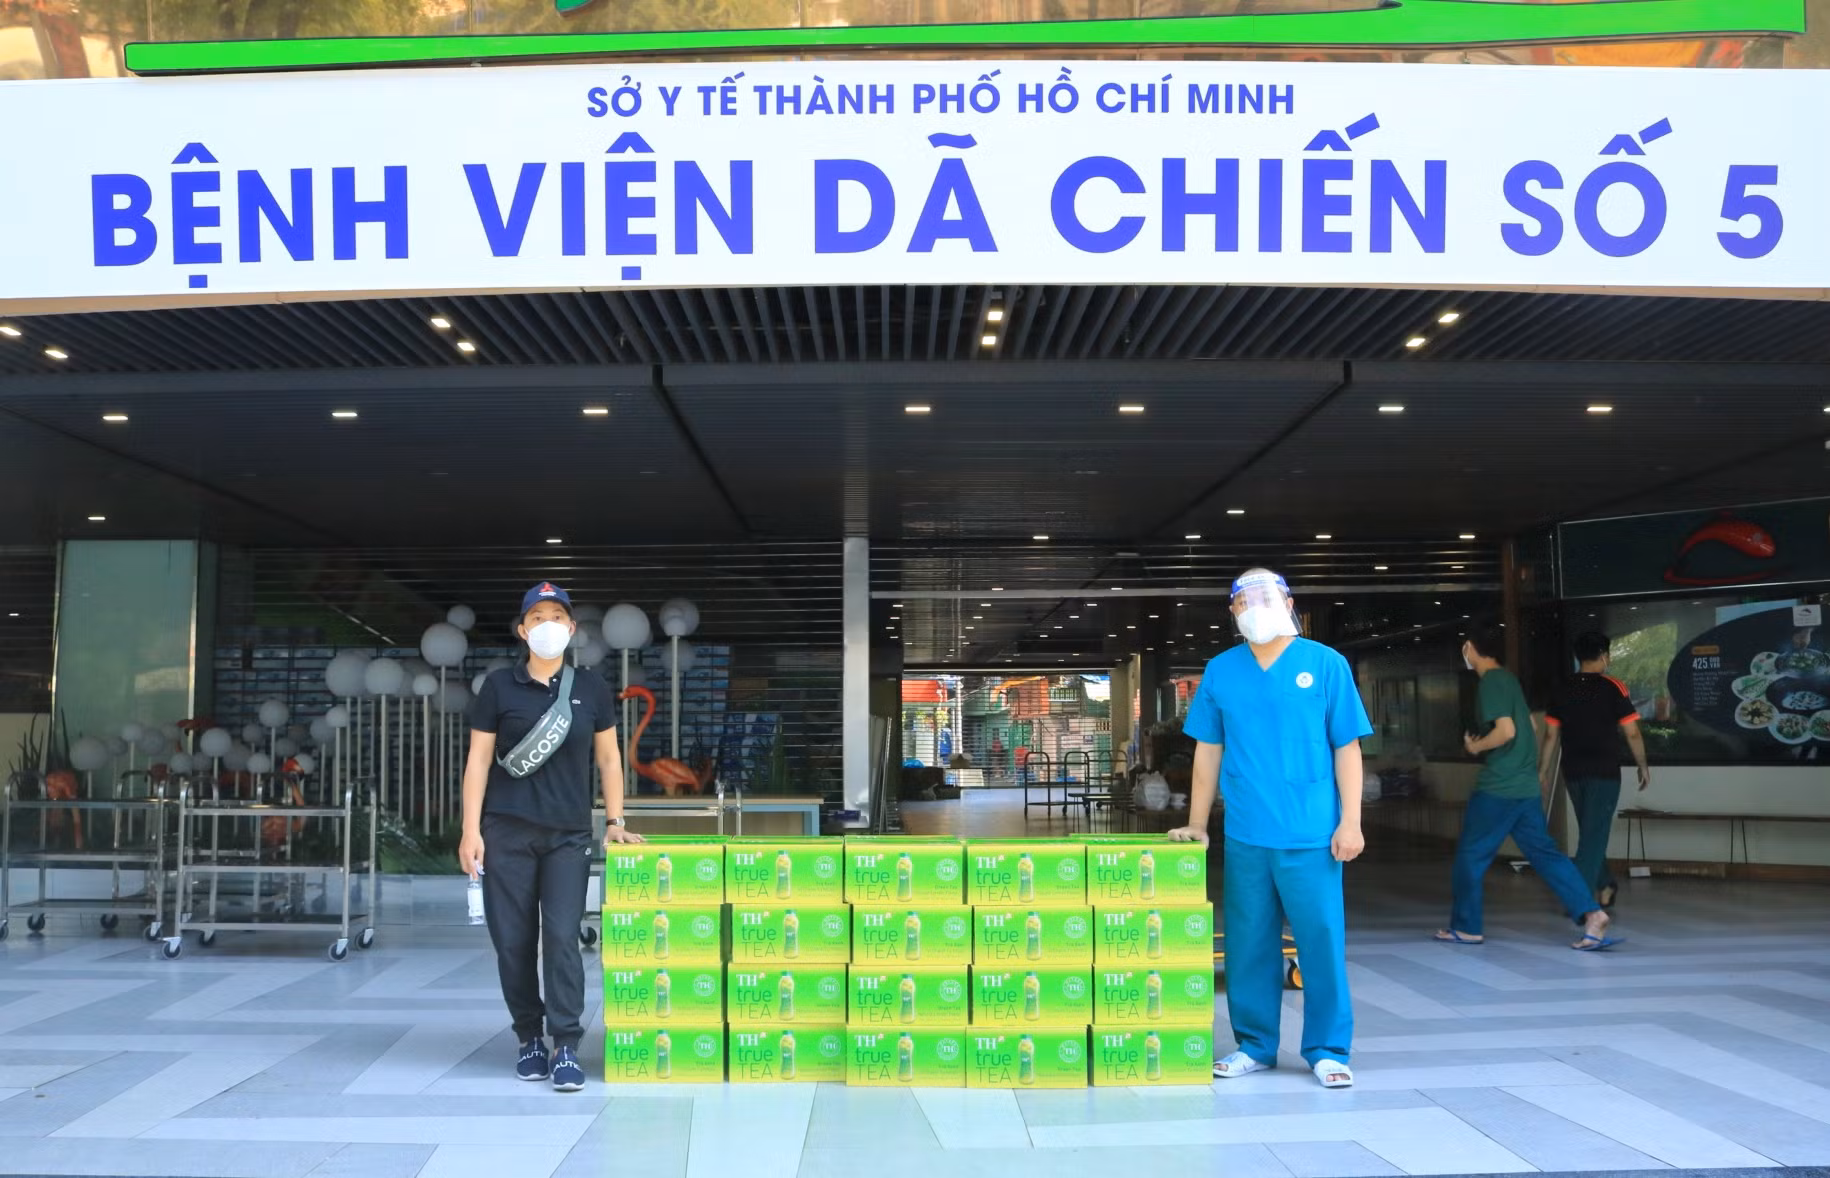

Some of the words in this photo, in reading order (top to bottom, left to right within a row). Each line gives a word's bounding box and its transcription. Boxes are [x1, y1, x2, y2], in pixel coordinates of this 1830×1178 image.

[587, 75, 642, 118] SỞ
[658, 86, 681, 117] Y
[697, 71, 745, 116] TẾ
[753, 75, 895, 115] THÀNH
[913, 69, 1002, 114] PHỐ
[1018, 67, 1079, 113] HỒ
[1095, 73, 1174, 113] CHÍ
[1188, 83, 1294, 115] MINH
[91, 142, 409, 289] BỆNH
[463, 131, 754, 281] VIỆN
[813, 132, 998, 254] DÃ
[1050, 112, 1447, 254] CHIẾN
[1501, 117, 1673, 258] SỐ
[1717, 164, 1784, 259] 5
[512, 714, 570, 776] LACOSTE
[615, 857, 636, 870] TH
[734, 853, 755, 866] TH
[855, 855, 876, 868] TH
[976, 857, 997, 870] TH
[1097, 853, 1118, 866] TH
[615, 870, 650, 885] true
[734, 866, 769, 881] true
[855, 868, 890, 883] true
[976, 870, 1011, 885] true
[1097, 866, 1132, 881] true
[615, 886, 651, 902] TEA
[734, 882, 770, 898] TEA
[855, 884, 891, 900] TEA
[976, 886, 1012, 902] TEA
[1097, 882, 1133, 898] TEA
[612, 913, 633, 926] TH
[741, 913, 762, 926] TH
[863, 914, 884, 927] TH
[984, 915, 1005, 928] TH
[1104, 913, 1125, 926] TH
[612, 926, 647, 941] true
[741, 926, 776, 941] true
[863, 927, 898, 942] true
[984, 928, 1019, 943] true
[1104, 926, 1139, 941] true
[612, 942, 648, 958] TEA
[741, 942, 777, 958] TEA
[863, 943, 899, 959] TEA
[984, 944, 1020, 960] TEA
[1104, 942, 1140, 958] TEA
[613, 972, 634, 985] TH
[737, 974, 758, 987] TH
[858, 977, 879, 990] TH
[982, 975, 1003, 988] TH
[1104, 973, 1125, 986] TH
[613, 985, 648, 1000] true
[737, 987, 772, 1002] true
[858, 990, 893, 1005] true
[982, 988, 1017, 1003] true
[1104, 986, 1139, 1001] true
[613, 1001, 649, 1017] TEA
[737, 1003, 773, 1019] TEA
[858, 1006, 894, 1022] TEA
[982, 1004, 1018, 1020] TEA
[1104, 1002, 1140, 1018] TEA
[614, 1033, 635, 1046] TH
[738, 1034, 759, 1047] TH
[856, 1035, 877, 1048] TH
[976, 1038, 997, 1051] TH
[1103, 1035, 1124, 1048] TH
[614, 1046, 649, 1061] true
[738, 1047, 773, 1062] true
[856, 1048, 891, 1063] true
[976, 1051, 1011, 1066] true
[1103, 1048, 1138, 1063] true
[614, 1062, 650, 1078] TEA
[738, 1063, 774, 1079] TEA
[856, 1064, 892, 1080] TEA
[976, 1067, 1012, 1083] TEA
[1103, 1064, 1139, 1080] TEA
